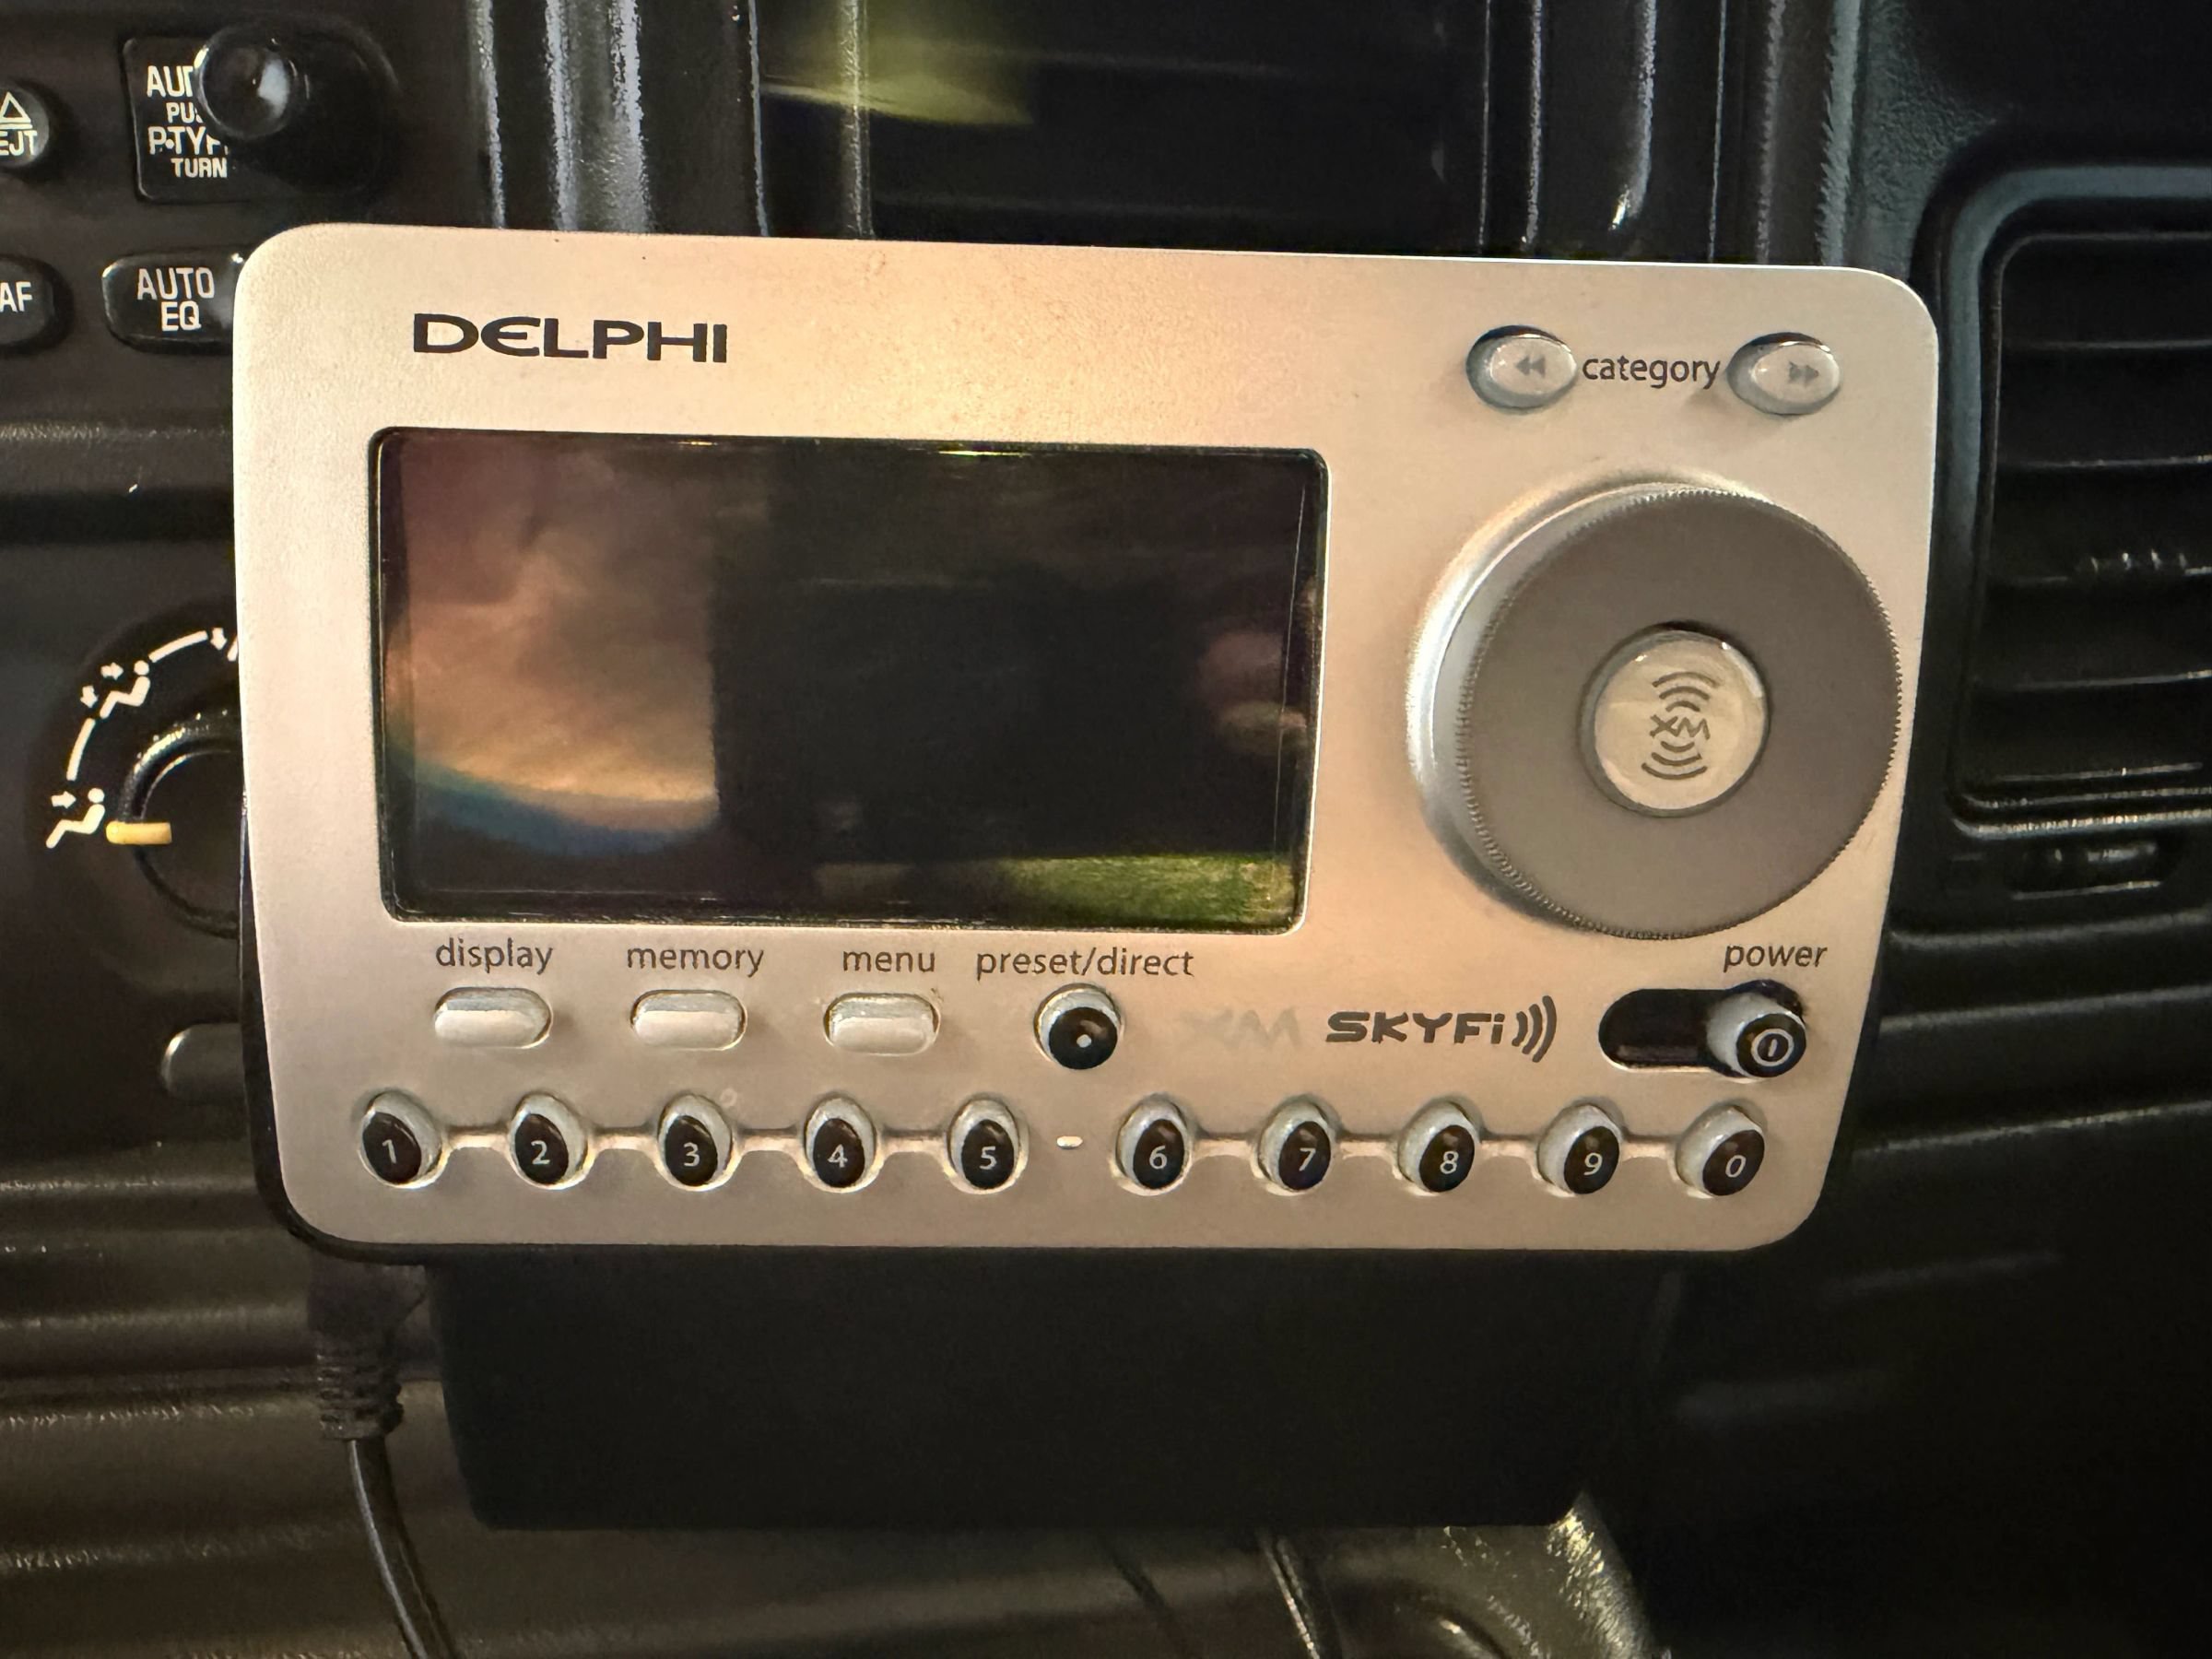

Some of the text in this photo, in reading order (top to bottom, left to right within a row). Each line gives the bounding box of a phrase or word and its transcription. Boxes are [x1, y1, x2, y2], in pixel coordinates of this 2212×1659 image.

[171, 158, 228, 178] TURN
[137, 267, 215, 300] AUTO
[161, 301, 201, 332] EQ
[414, 313, 727, 362] DELPHI
[1583, 355, 1721, 389] category
[1649, 713, 1711, 740] XM
[435, 938, 554, 974] display
[627, 946, 765, 977] memory
[842, 950, 936, 972] menu
[976, 947, 1194, 981] preset/direct
[1724, 945, 1829, 972] power
[382, 1139, 398, 1164] 1
[531, 1141, 551, 1166] 2
[683, 1143, 700, 1167] 3
[828, 1150, 847, 1169] 4
[980, 1147, 997, 1171] 5
[1148, 1146, 1168, 1171] 6
[1299, 1147, 1316, 1172] 7
[1440, 1151, 1458, 1176] 8
[1583, 1153, 1604, 1177] 9
[1725, 1156, 1747, 1179] 0
